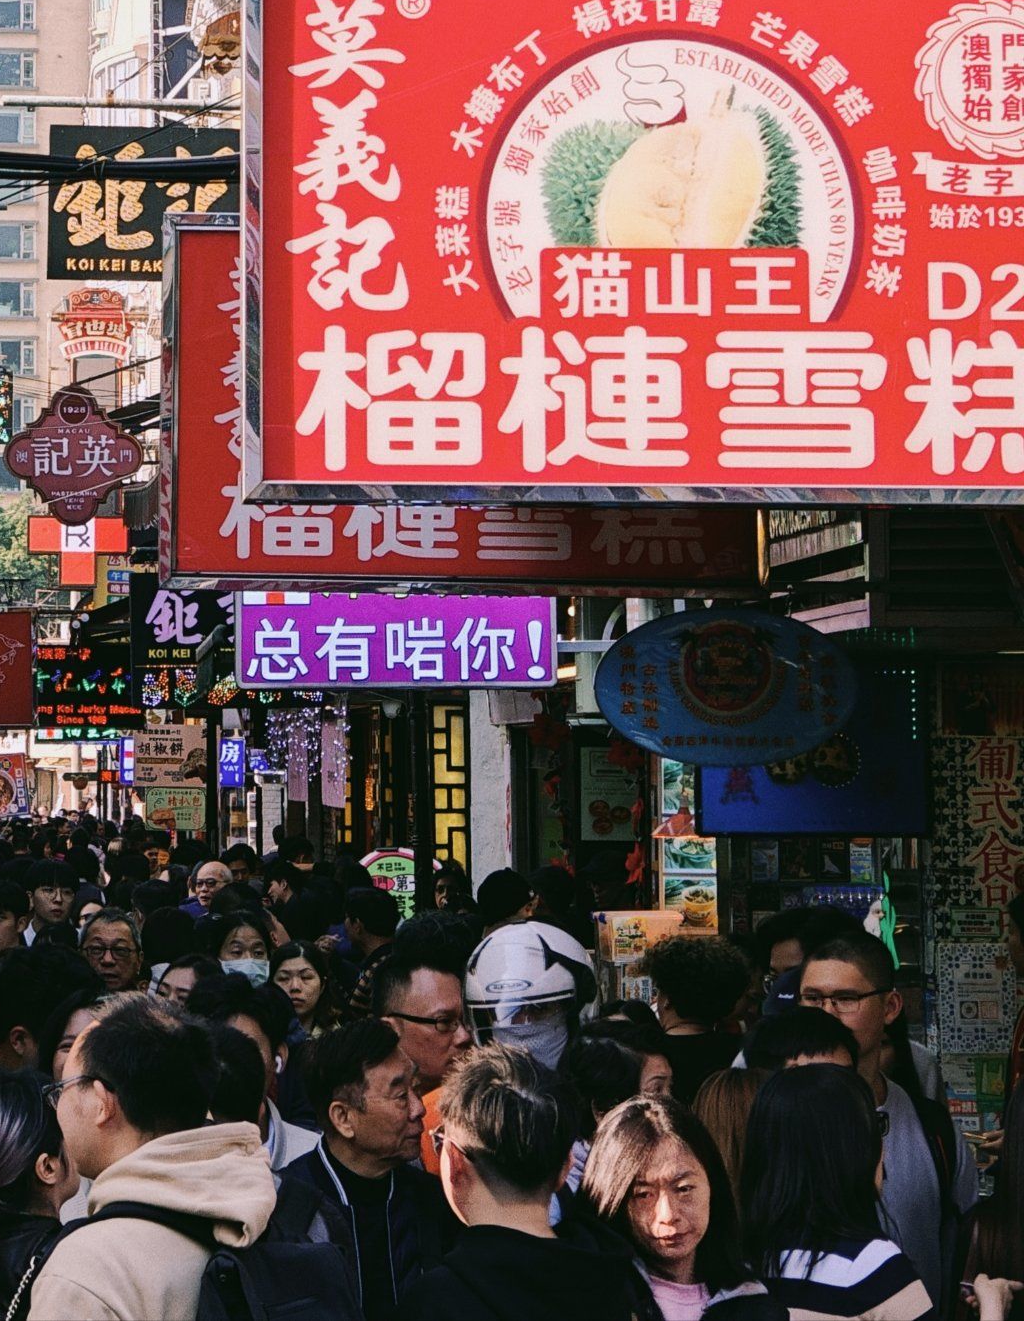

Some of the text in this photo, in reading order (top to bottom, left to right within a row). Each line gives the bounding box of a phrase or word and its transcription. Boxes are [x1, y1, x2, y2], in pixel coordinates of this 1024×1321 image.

[749, 10, 875, 129] 芒果雪糕
[674, 47, 848, 301] ESTABLISHED MORE THAN 80 YEARS
[861, 145, 909, 300] 咖啡奶茶
[66, 257, 95, 272] KOI
[99, 257, 126, 272] KEI
[553, 250, 803, 319] 猫山王
[62, 405, 86, 415] 1928
[148, 648, 192, 659] KOI KEI
